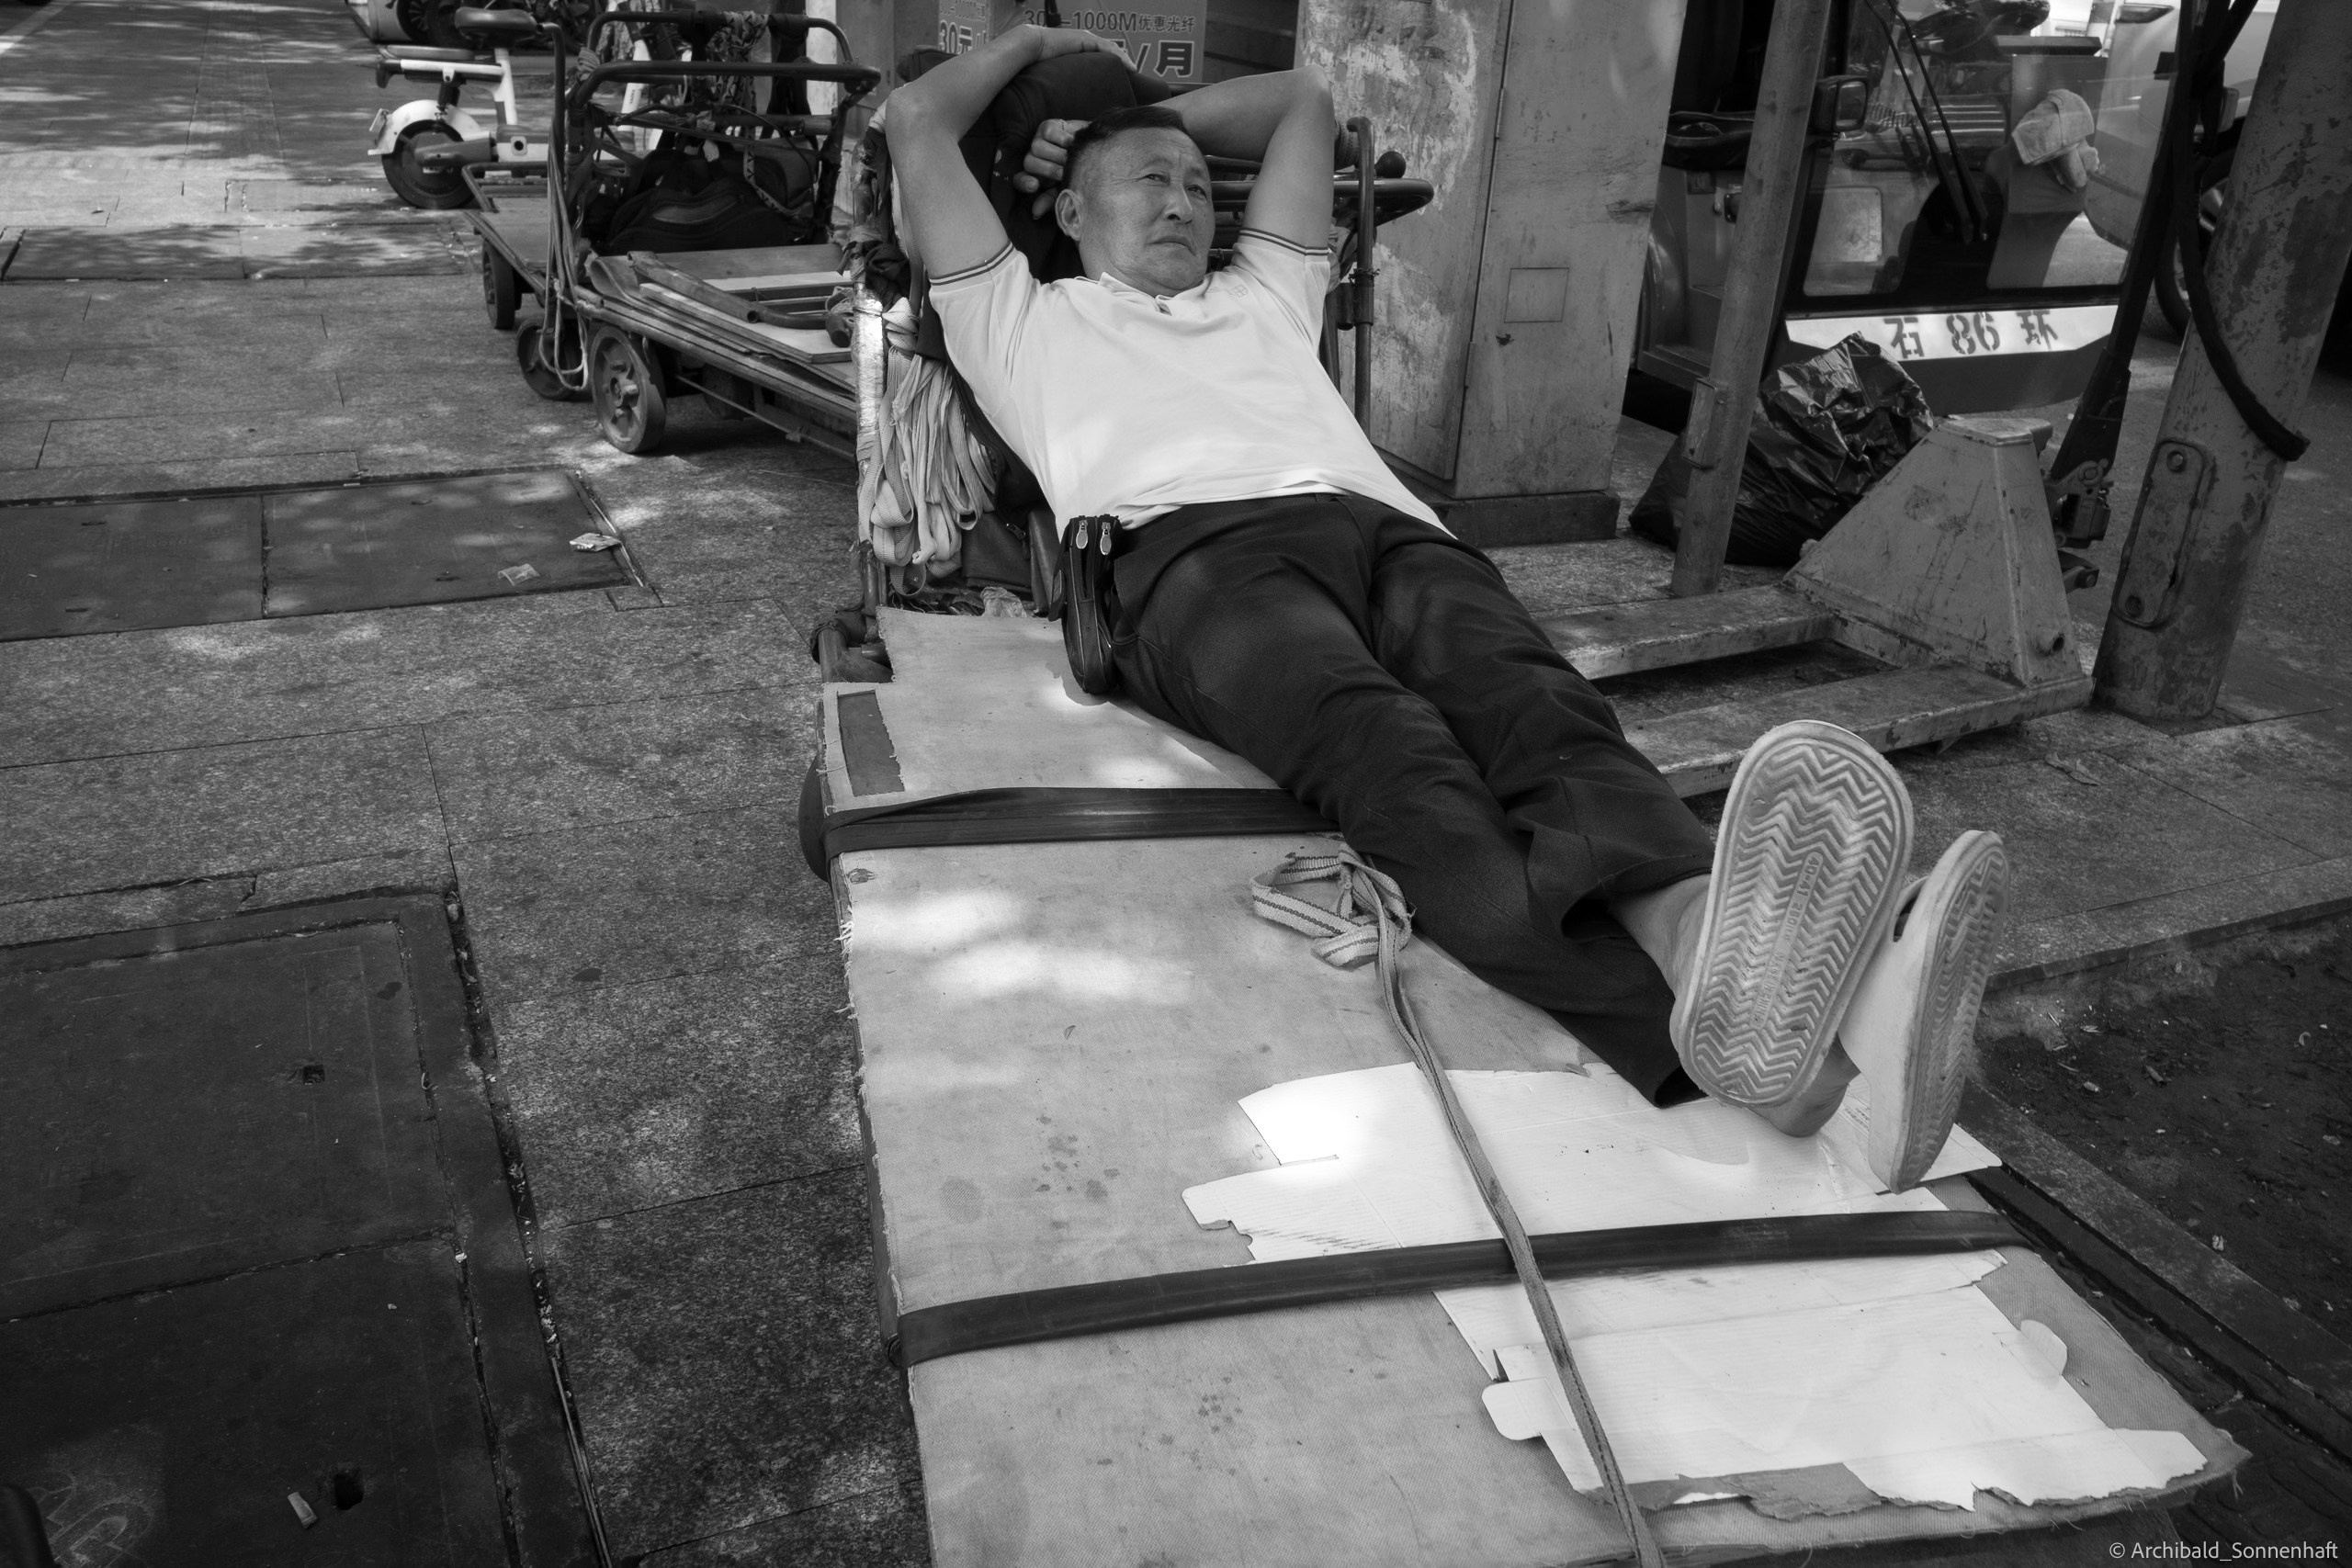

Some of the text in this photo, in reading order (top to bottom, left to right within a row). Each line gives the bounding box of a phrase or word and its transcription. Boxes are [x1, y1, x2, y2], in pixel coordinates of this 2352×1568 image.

[1884, 316, 1924, 359] 石
[1946, 311, 2000, 355] 86
[1797, 856, 1819, 897] 40-41
